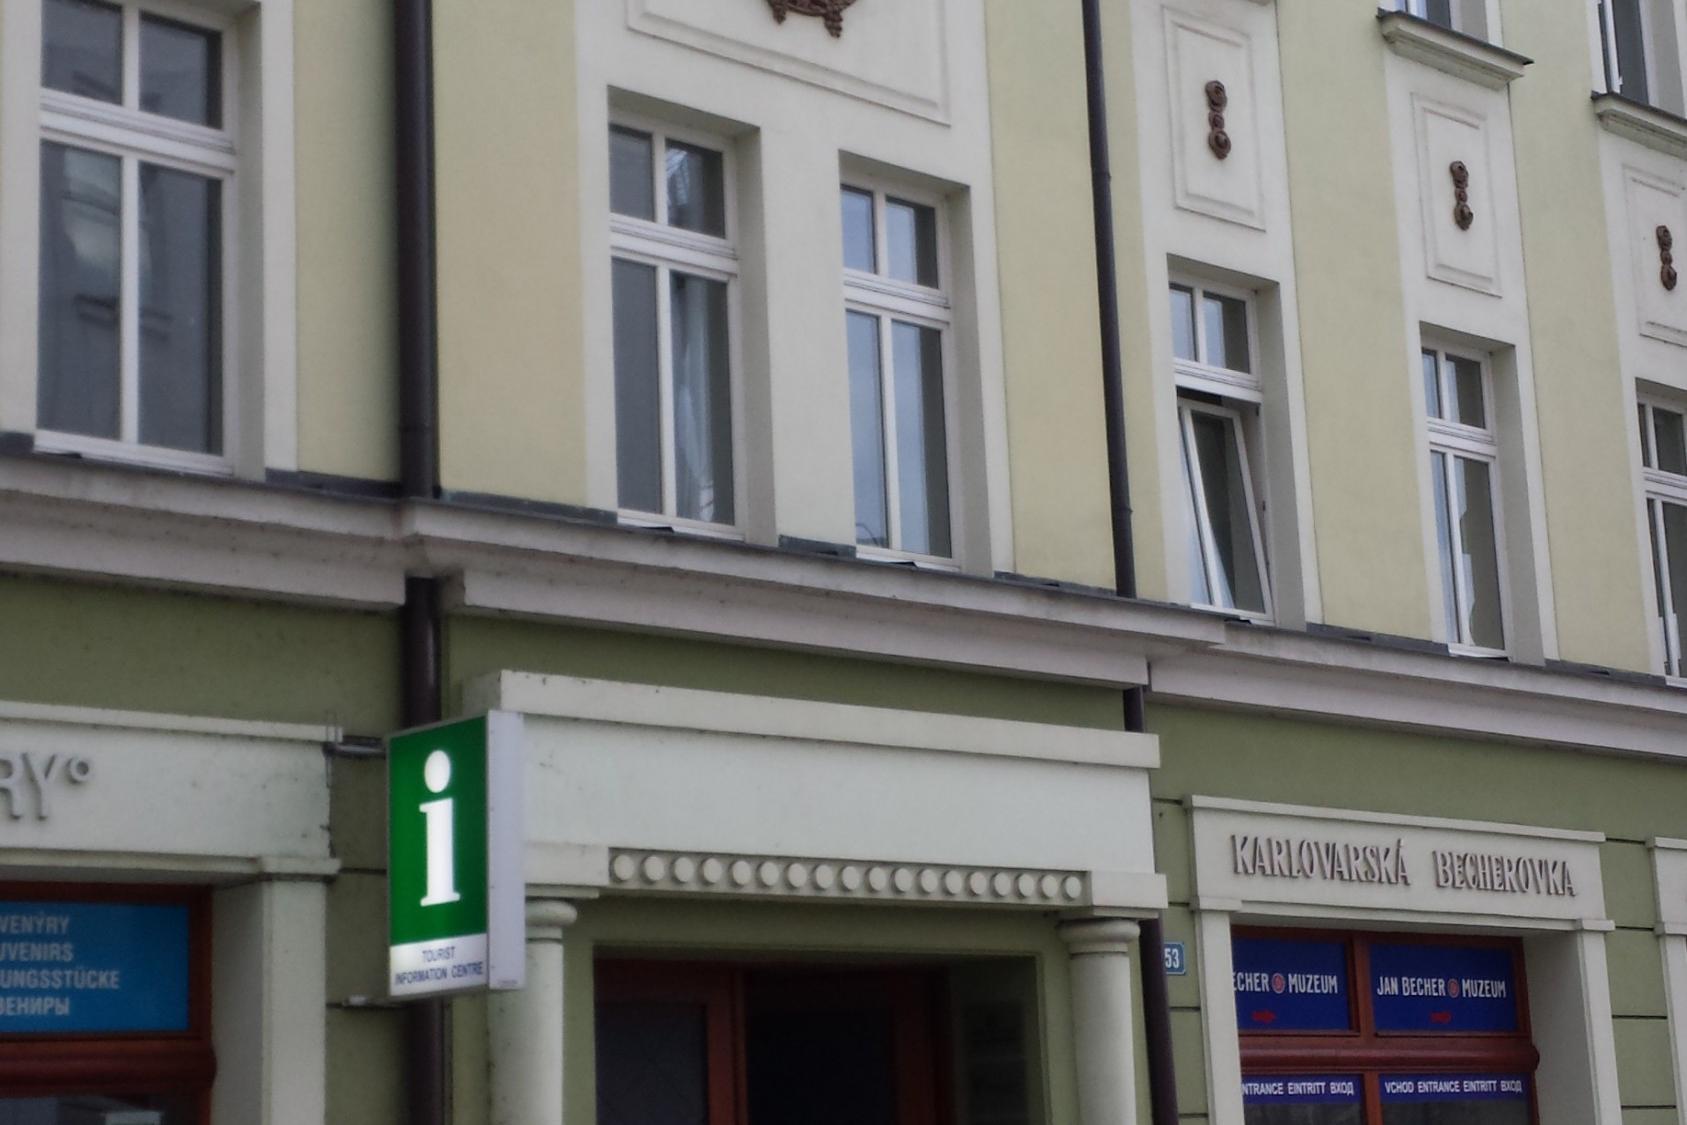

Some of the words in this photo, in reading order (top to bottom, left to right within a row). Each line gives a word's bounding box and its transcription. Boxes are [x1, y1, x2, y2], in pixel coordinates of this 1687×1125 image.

[1231, 834, 1410, 886] KARLOVARSKÁ
[1432, 850, 1576, 897] BECHEROVKA
[422, 946, 456, 962] TOURIST
[395, 968, 447, 985] INFORMATION
[451, 961, 483, 978] CENTRE
[1288, 973, 1338, 994] MUZEUM
[1377, 976, 1399, 995] JAN
[1401, 976, 1446, 996] BECHER
[1462, 979, 1507, 998] MUZEUM
[1287, 1082, 1327, 1094] EINTRITT
[1330, 1082, 1354, 1096] ВХОД
[1385, 1081, 1415, 1094] VCHOD
[1417, 1081, 1461, 1093] ENTRANCE
[1463, 1080, 1498, 1092] EINTRITT
[1500, 1080, 1523, 1093] ВХОД
